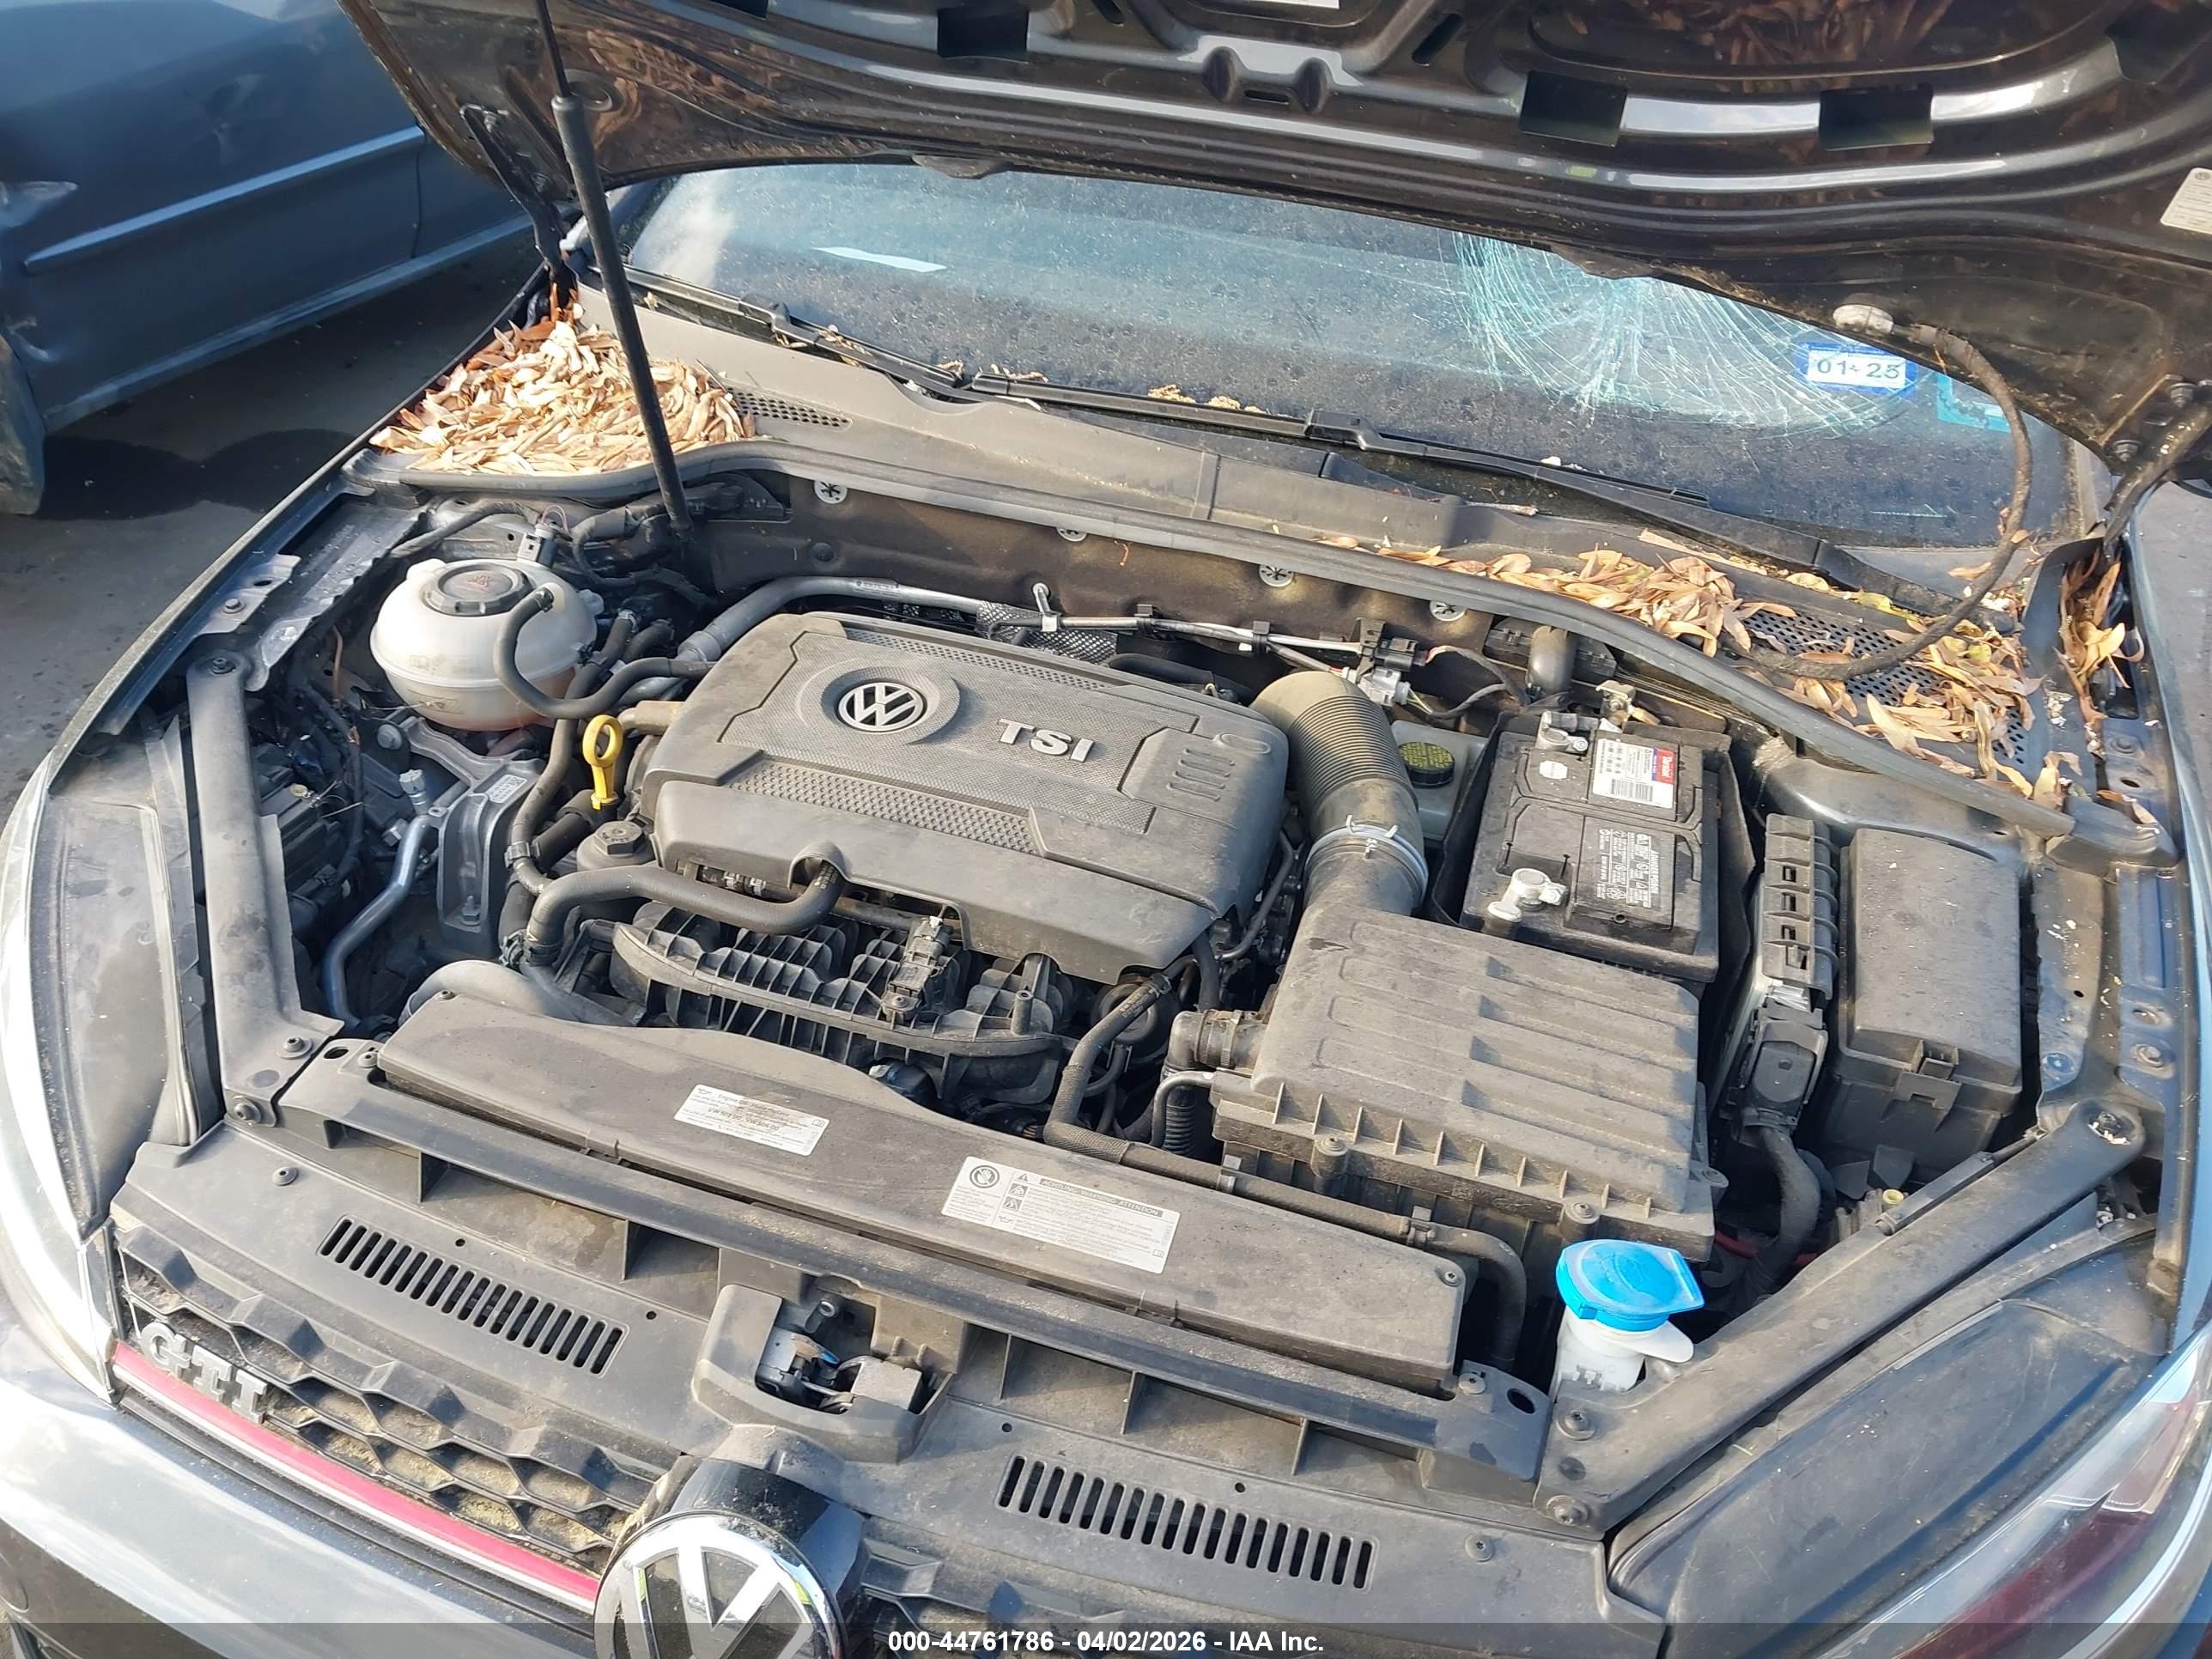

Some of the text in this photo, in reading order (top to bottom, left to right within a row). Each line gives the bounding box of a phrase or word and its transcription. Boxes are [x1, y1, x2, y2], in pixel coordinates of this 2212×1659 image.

[845, 683, 920, 731] VW
[999, 718, 1095, 763] TSI
[1080, 1189, 1115, 1204] WARNING
[1118, 1200, 1159, 1216] ATTENTION
[140, 1321, 270, 1425] GTI
